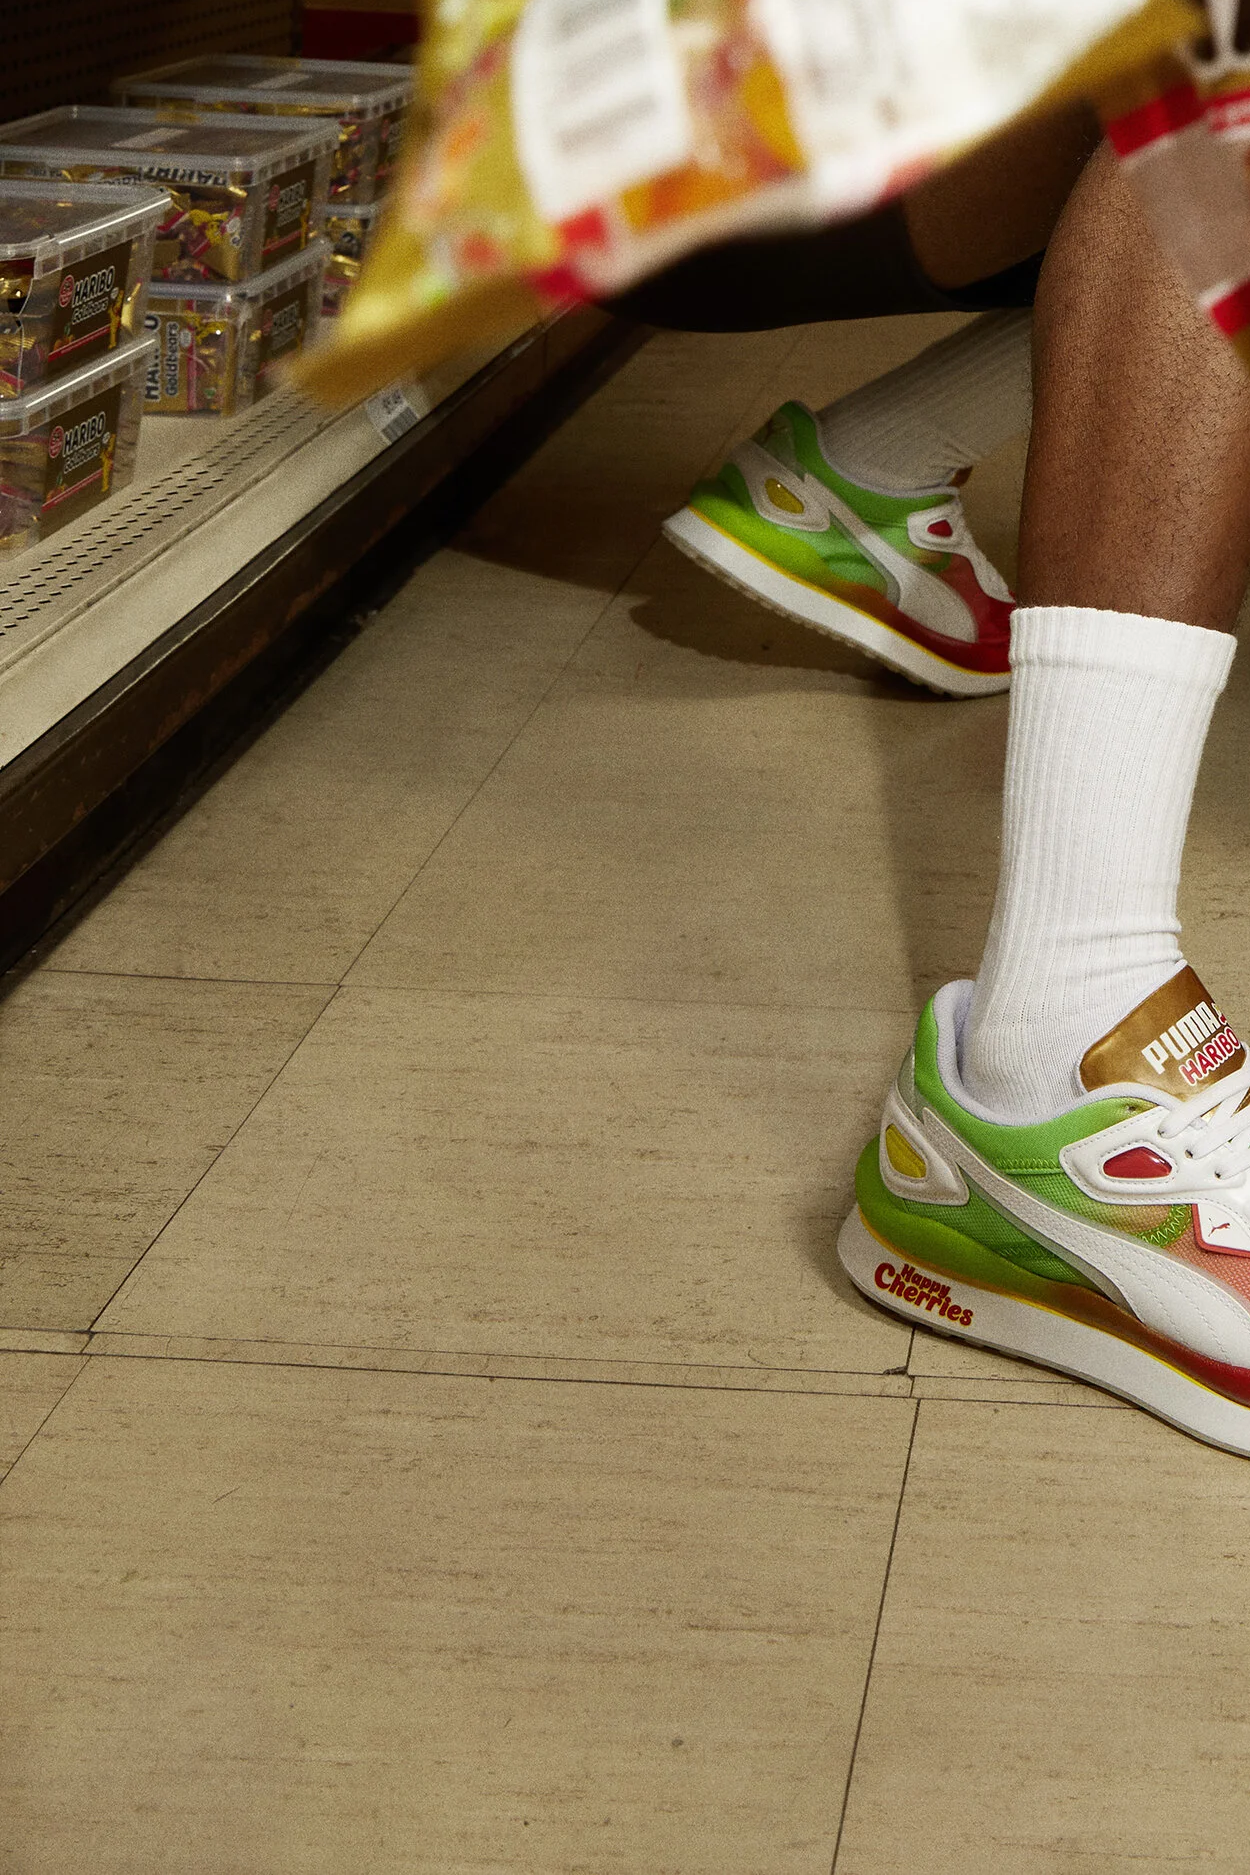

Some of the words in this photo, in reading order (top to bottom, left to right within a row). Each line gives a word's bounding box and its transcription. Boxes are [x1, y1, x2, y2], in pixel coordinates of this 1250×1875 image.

[71, 291, 109, 327] Goldbears
[72, 265, 116, 309] HARIBO
[165, 321, 180, 398] Goldbears
[62, 410, 107, 457] HARIBO
[62, 433, 101, 475] Goldbears
[1141, 1001, 1222, 1075] PUMA
[1178, 1026, 1242, 1086] HARIBO
[874, 1261, 974, 1327] Cherries
[900, 1262, 952, 1299] Happy
